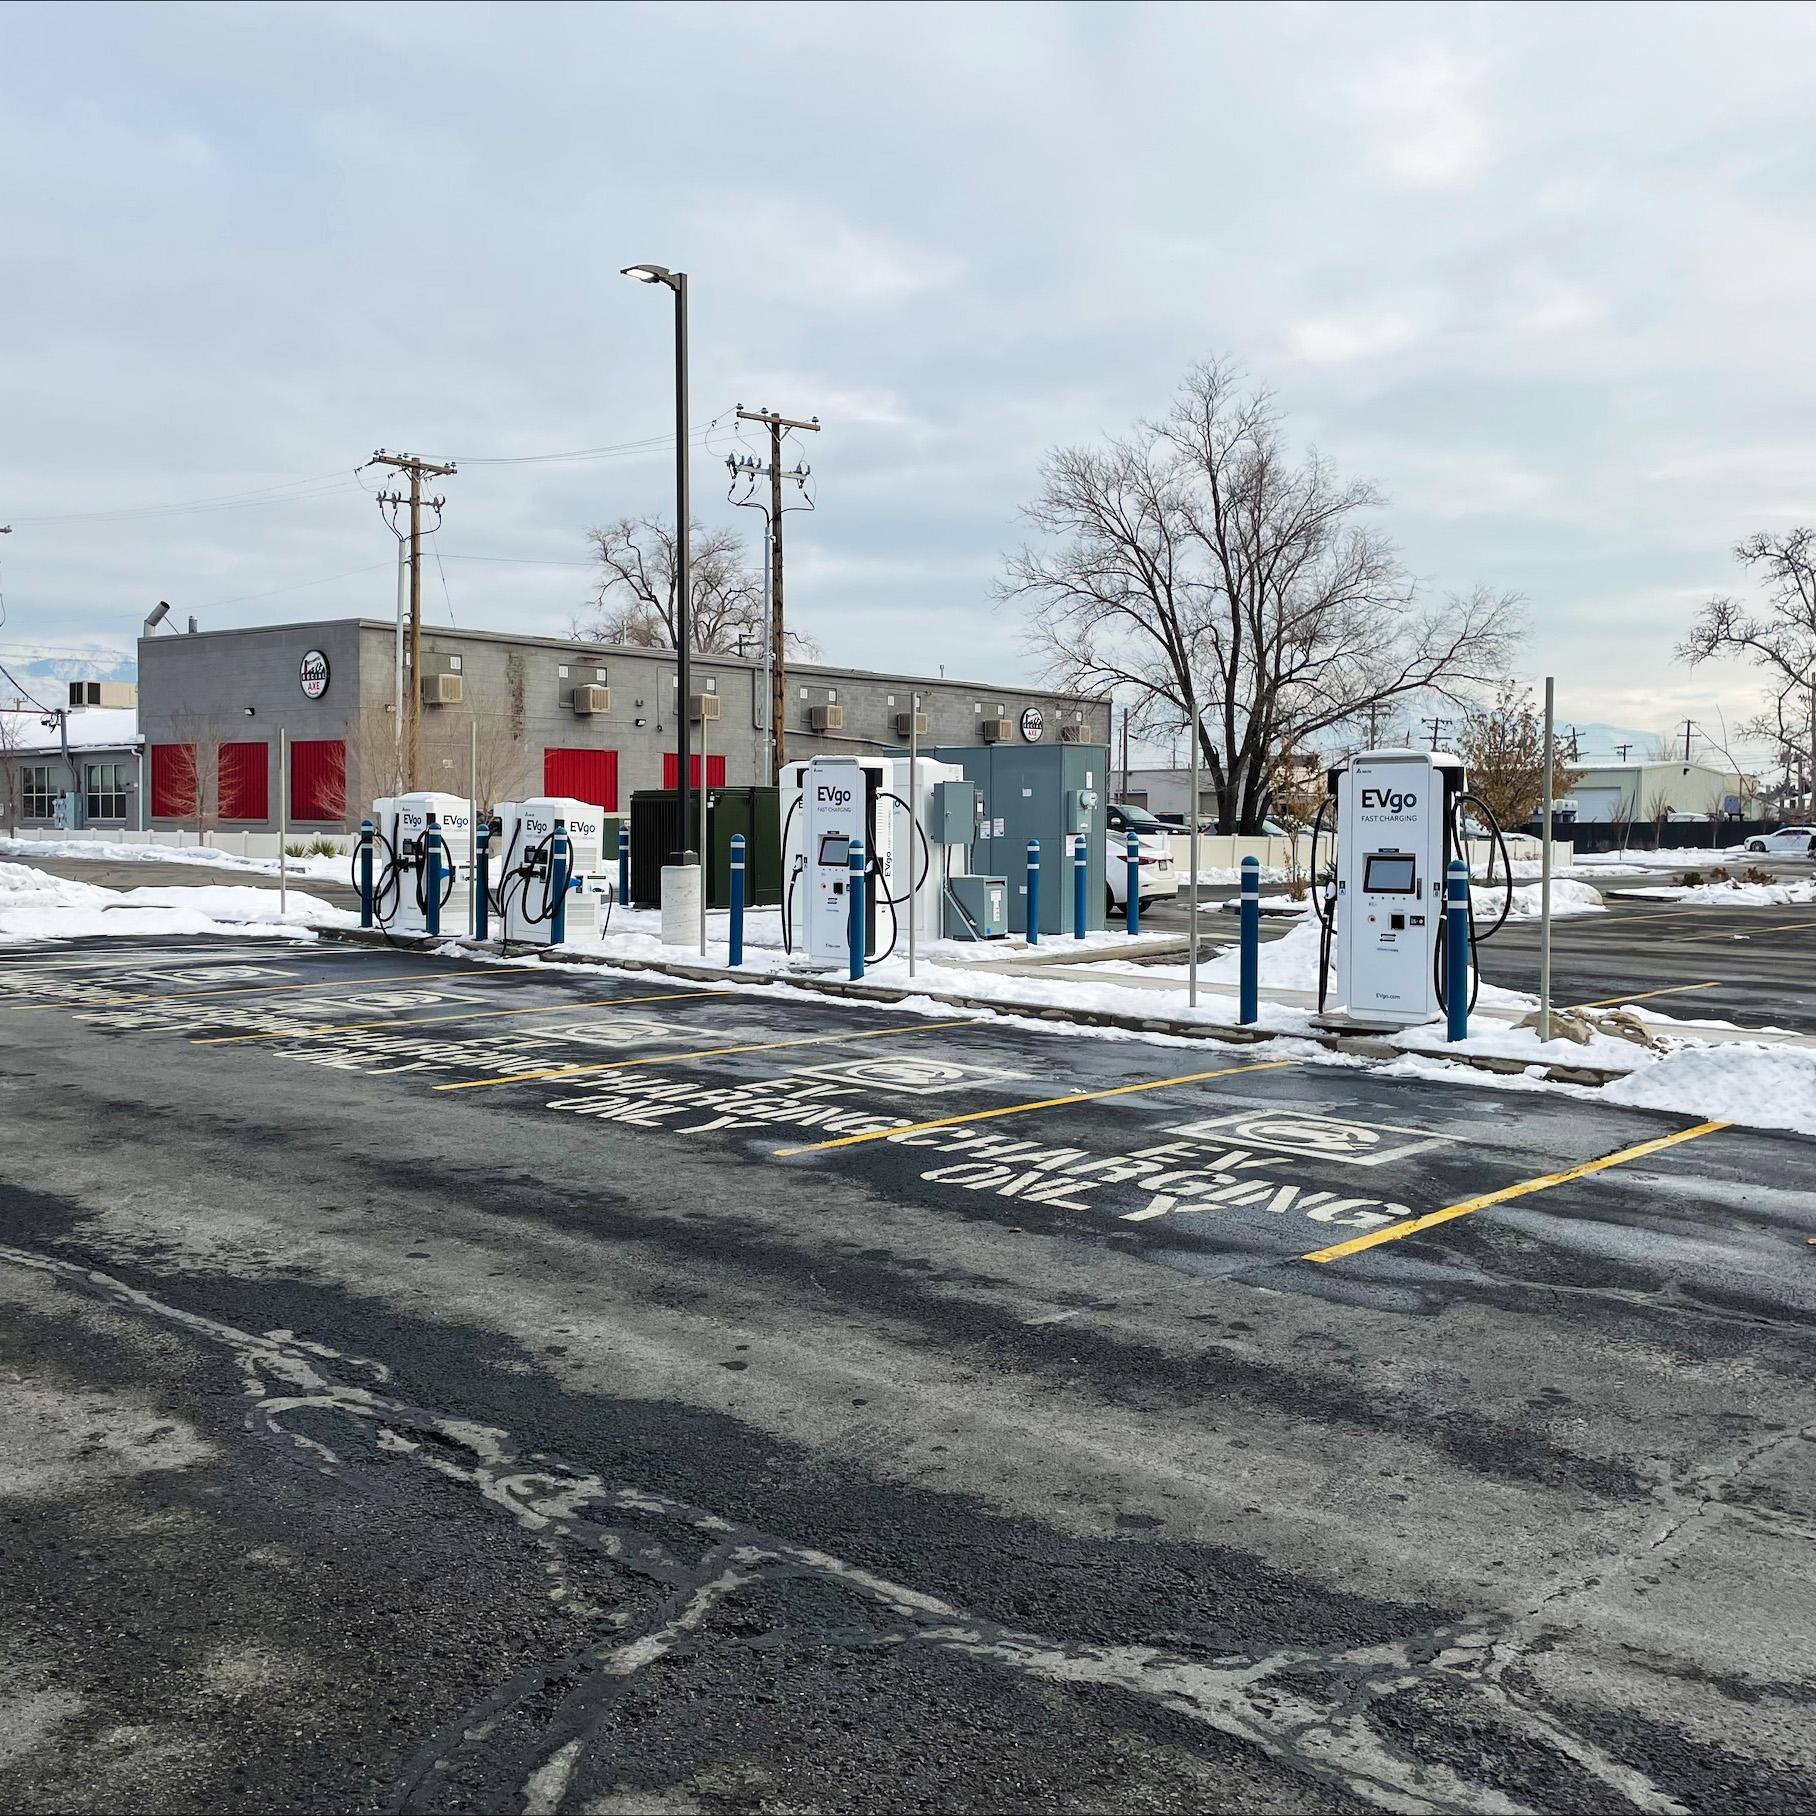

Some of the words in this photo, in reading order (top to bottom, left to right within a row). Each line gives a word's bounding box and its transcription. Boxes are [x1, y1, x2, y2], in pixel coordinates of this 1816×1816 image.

[308, 681, 320, 691] AXE
[817, 786, 851, 806] EVgo
[1361, 788, 1417, 814] EVgo
[403, 814, 422, 828] EVgo
[443, 815, 469, 828] EVgo
[526, 820, 548, 834] EVgo
[570, 821, 596, 836] EVgo
[1379, 814, 1418, 822] CHARGING
[884, 851, 893, 877] EVgo
[735, 1076, 867, 1100] EV
[552, 1070, 913, 1135] CHARGING
[546, 1096, 772, 1135] ONLY
[1132, 1141, 1294, 1172] EV
[887, 1126, 1413, 1229] CHARGING
[920, 1162, 1229, 1222] ONLY
